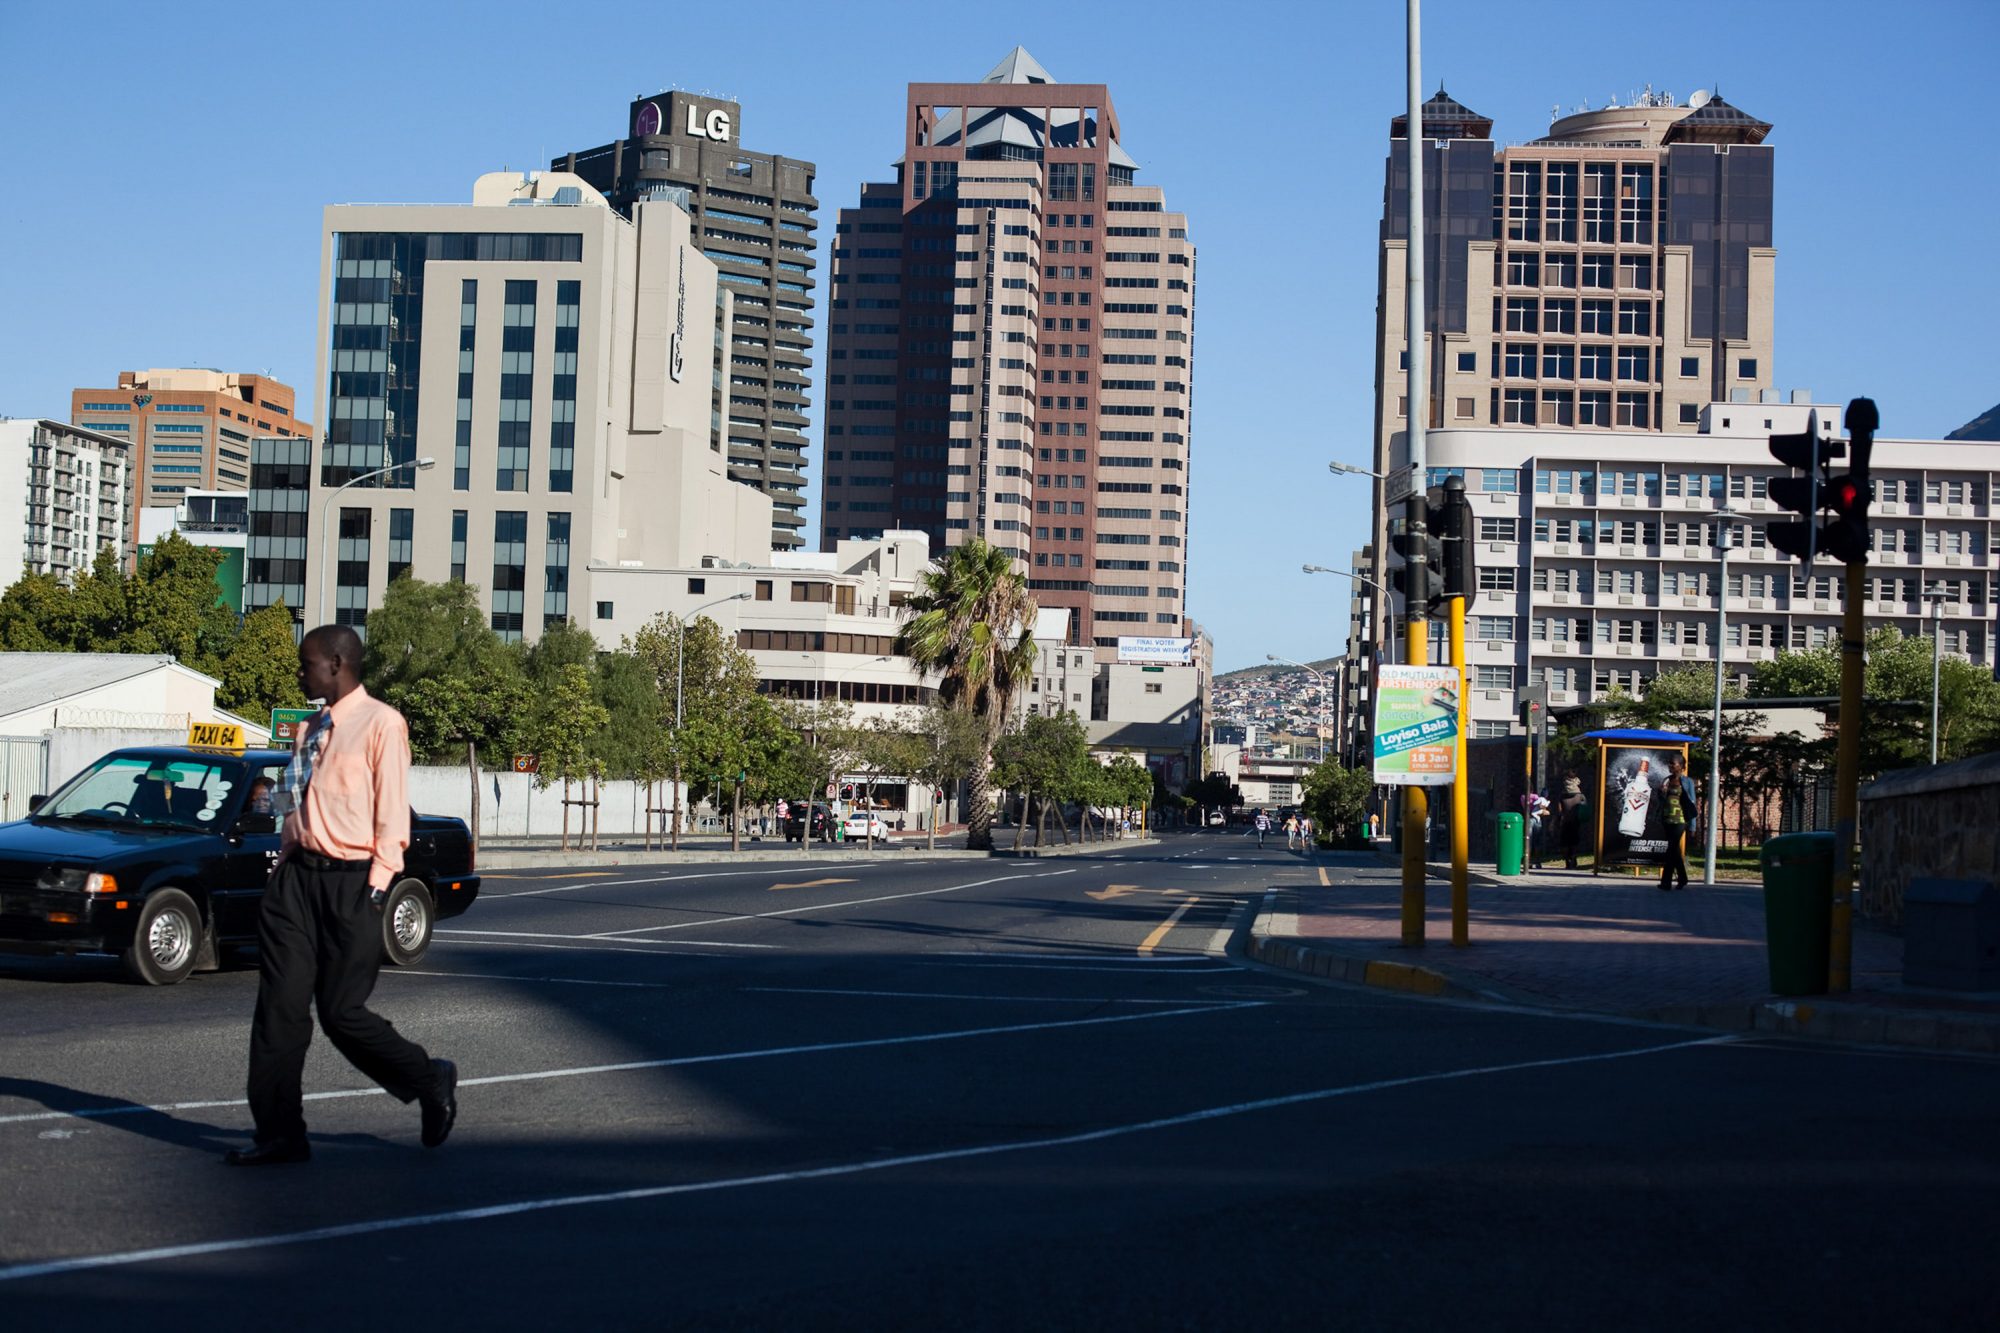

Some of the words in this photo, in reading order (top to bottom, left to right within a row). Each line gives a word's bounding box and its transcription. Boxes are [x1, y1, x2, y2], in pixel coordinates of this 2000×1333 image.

[687, 104, 731, 142] LG
[1380, 670, 1398, 679] OLD
[1400, 671, 1440, 680] MUTUAL
[1379, 680, 1455, 690] KIRSTENBOSCH
[192, 725, 219, 745] TAXI
[221, 727, 237, 747] 64
[1381, 728, 1420, 746] Loyiso
[1421, 719, 1449, 734] Bala
[1411, 753, 1426, 763] 18
[1428, 754, 1449, 764] Jan
